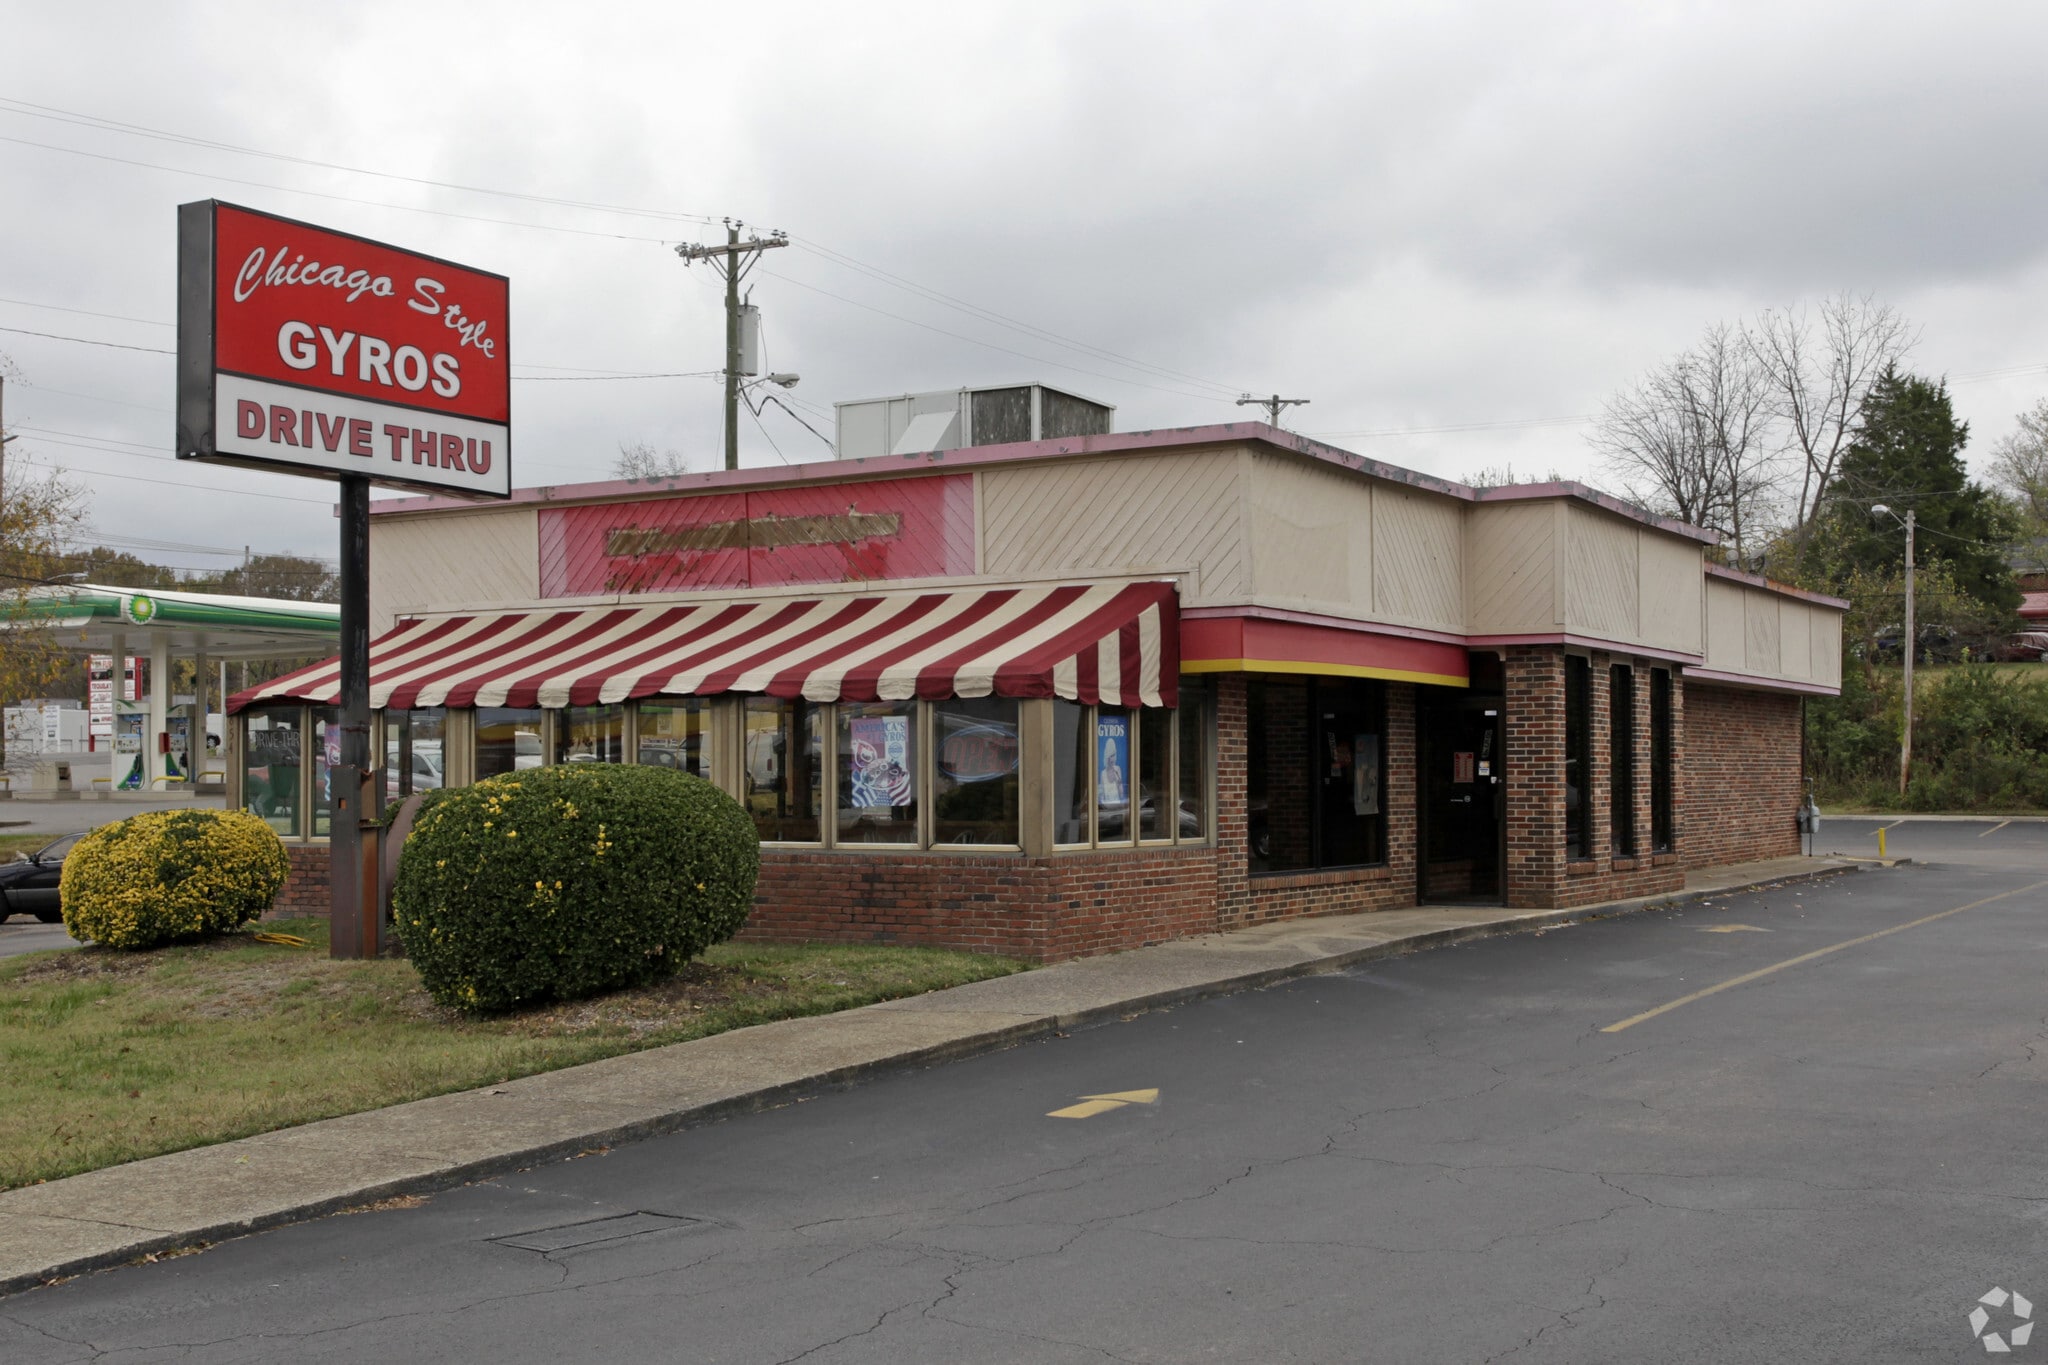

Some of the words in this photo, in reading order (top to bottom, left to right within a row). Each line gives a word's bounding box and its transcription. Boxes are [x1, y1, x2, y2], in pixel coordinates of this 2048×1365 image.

[233, 246, 395, 302] Chicago
[407, 277, 495, 358] Style
[277, 320, 462, 399] GYROS
[237, 398, 373, 457] DRIVE
[383, 423, 492, 475] THRU
[855, 721, 905, 733] AMERICA'S
[879, 731, 906, 743] GYROS
[1097, 724, 1125, 737] GYROS
